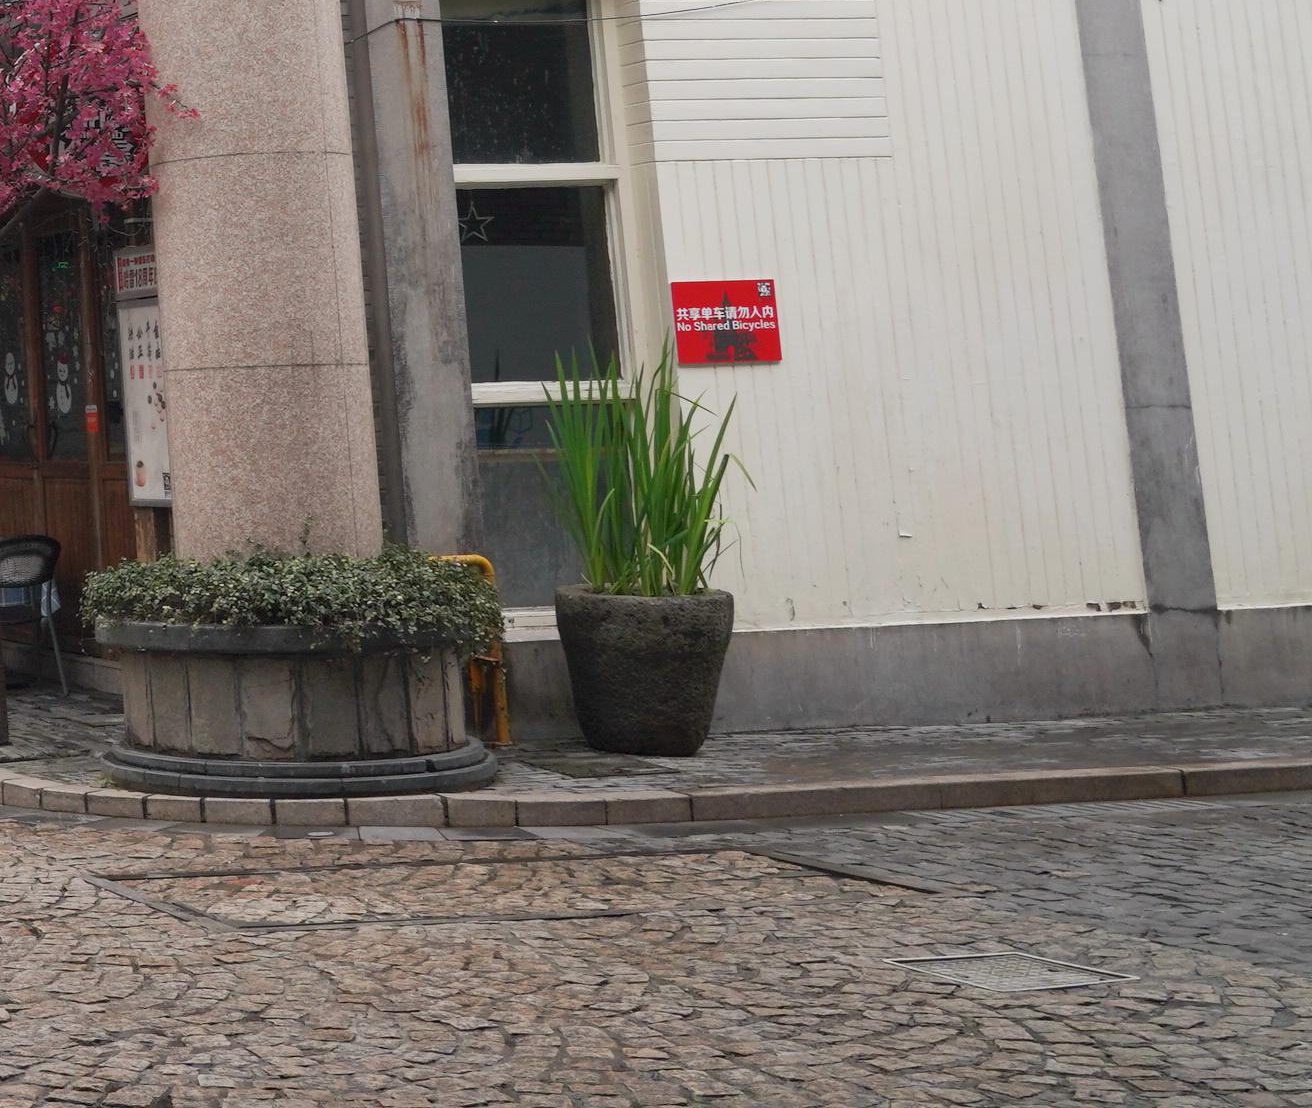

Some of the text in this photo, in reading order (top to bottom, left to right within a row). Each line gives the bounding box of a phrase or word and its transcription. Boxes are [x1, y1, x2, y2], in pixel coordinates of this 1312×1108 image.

[677, 305, 774, 321] 共享单车请勿入内
[677, 319, 776, 332] No Shared Bicycles
